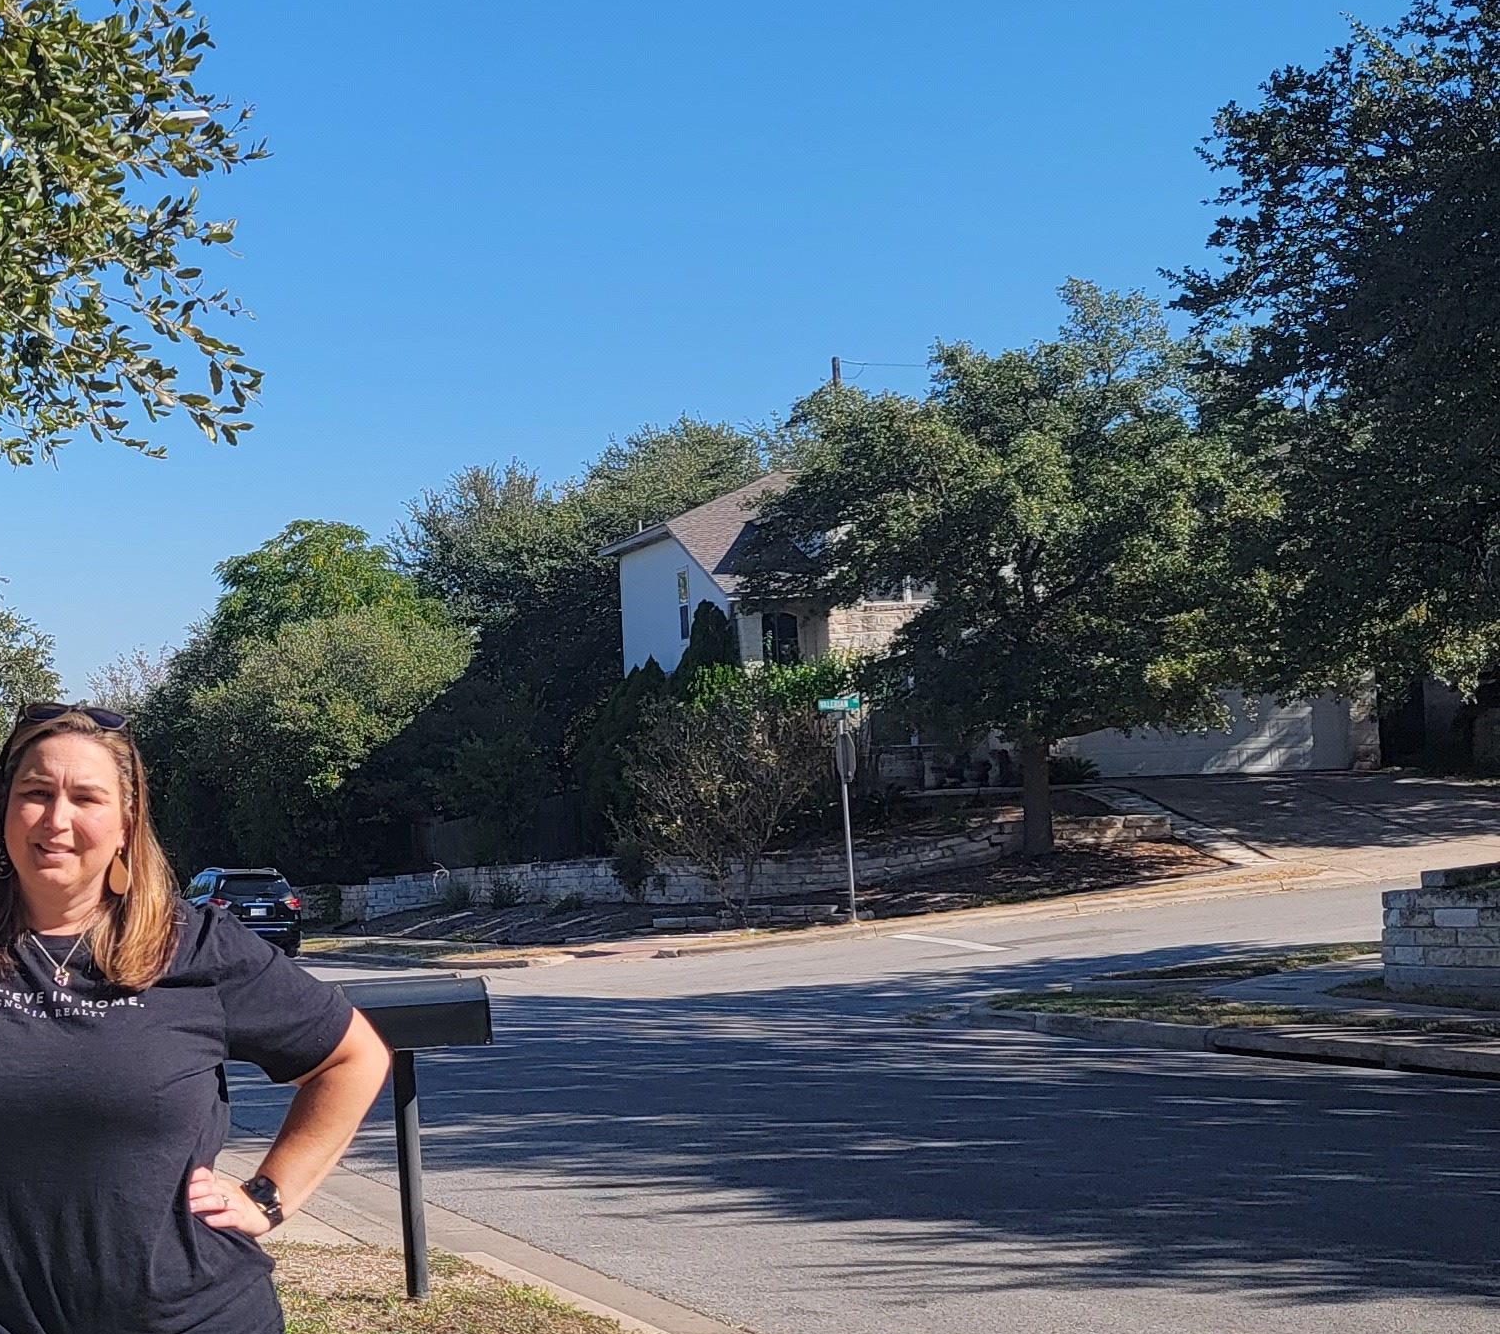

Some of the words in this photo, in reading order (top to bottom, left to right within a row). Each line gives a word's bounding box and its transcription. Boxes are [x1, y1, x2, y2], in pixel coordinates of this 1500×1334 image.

[53, 990, 73, 1003] IN
[81, 996, 145, 1008] HOME.
[55, 1007, 107, 1018] REALTY
